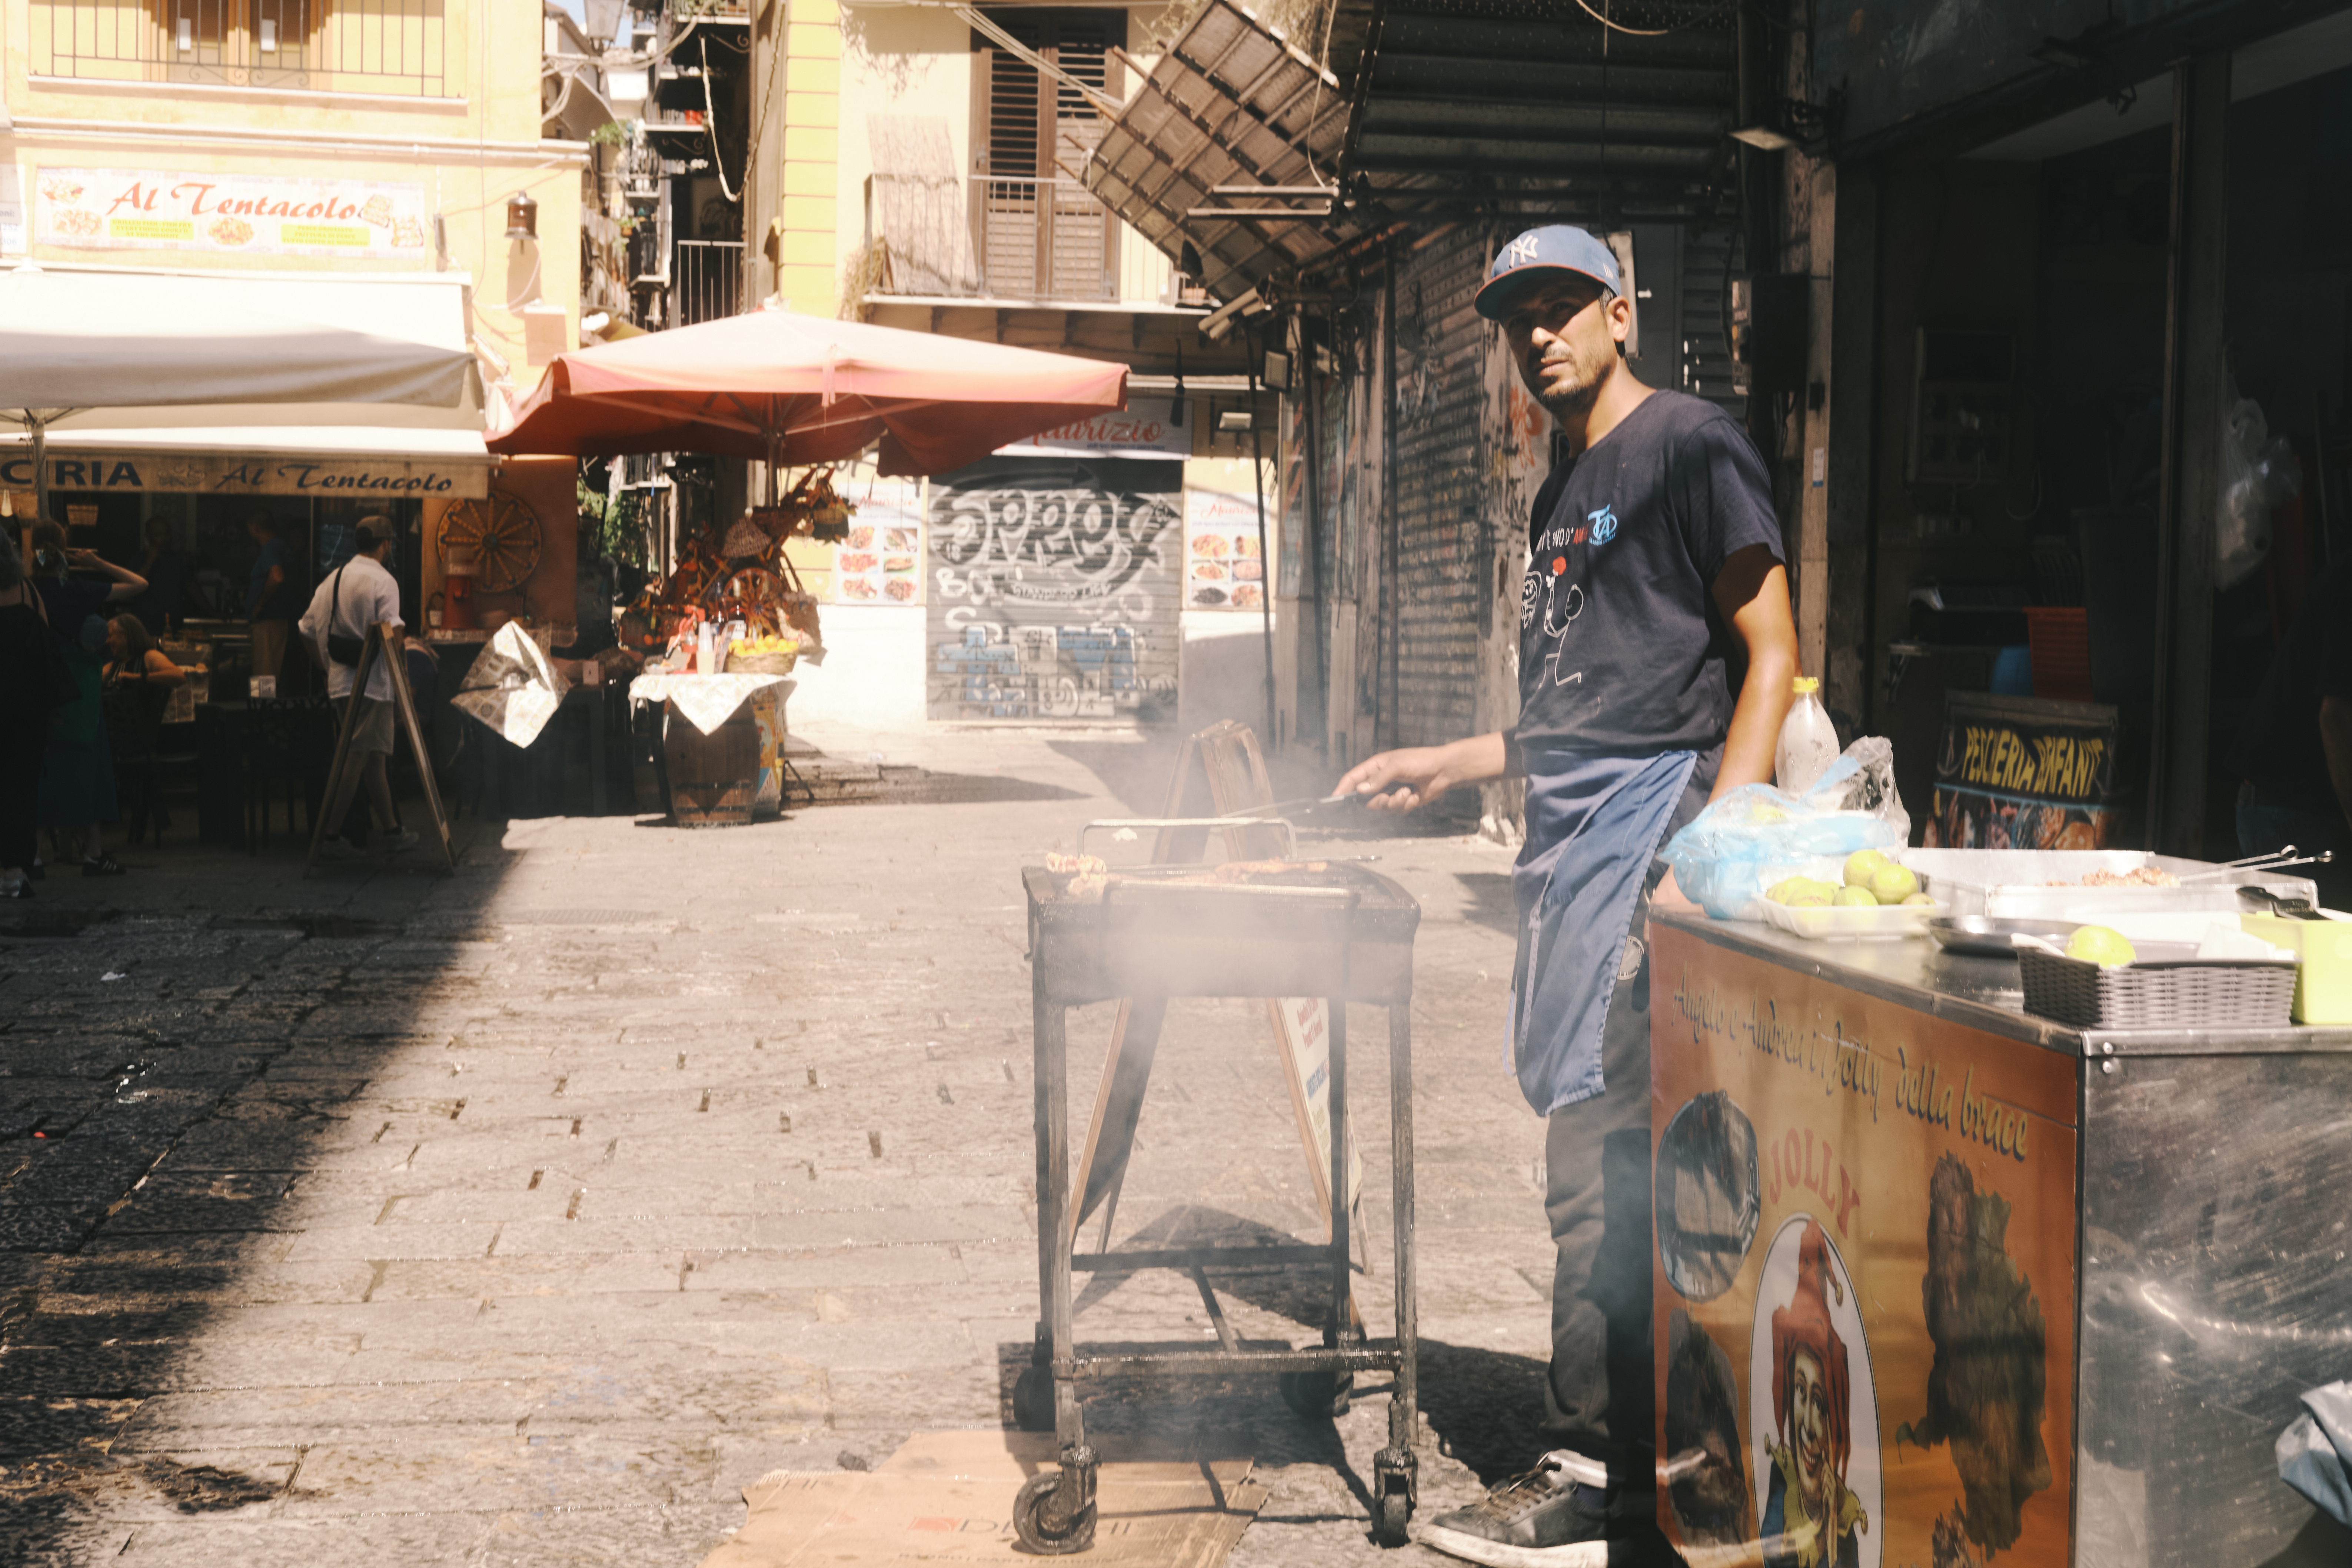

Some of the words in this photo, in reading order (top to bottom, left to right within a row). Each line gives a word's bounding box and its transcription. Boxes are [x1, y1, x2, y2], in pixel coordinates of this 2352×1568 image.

[106, 182, 158, 216] Al
[172, 182, 360, 220] Tentacolo
[1509, 234, 1538, 269] NY
[0, 459, 143, 487] CRIA
[216, 464, 265, 489] Al
[278, 464, 453, 491] Tentacolo
[1729, 1002, 1738, 1041] e
[1739, 983, 1804, 1069] Andrea
[1896, 1041, 1953, 1131] della
[1960, 1062, 2028, 1163] brace
[1769, 1126, 1860, 1240] JOLLY
